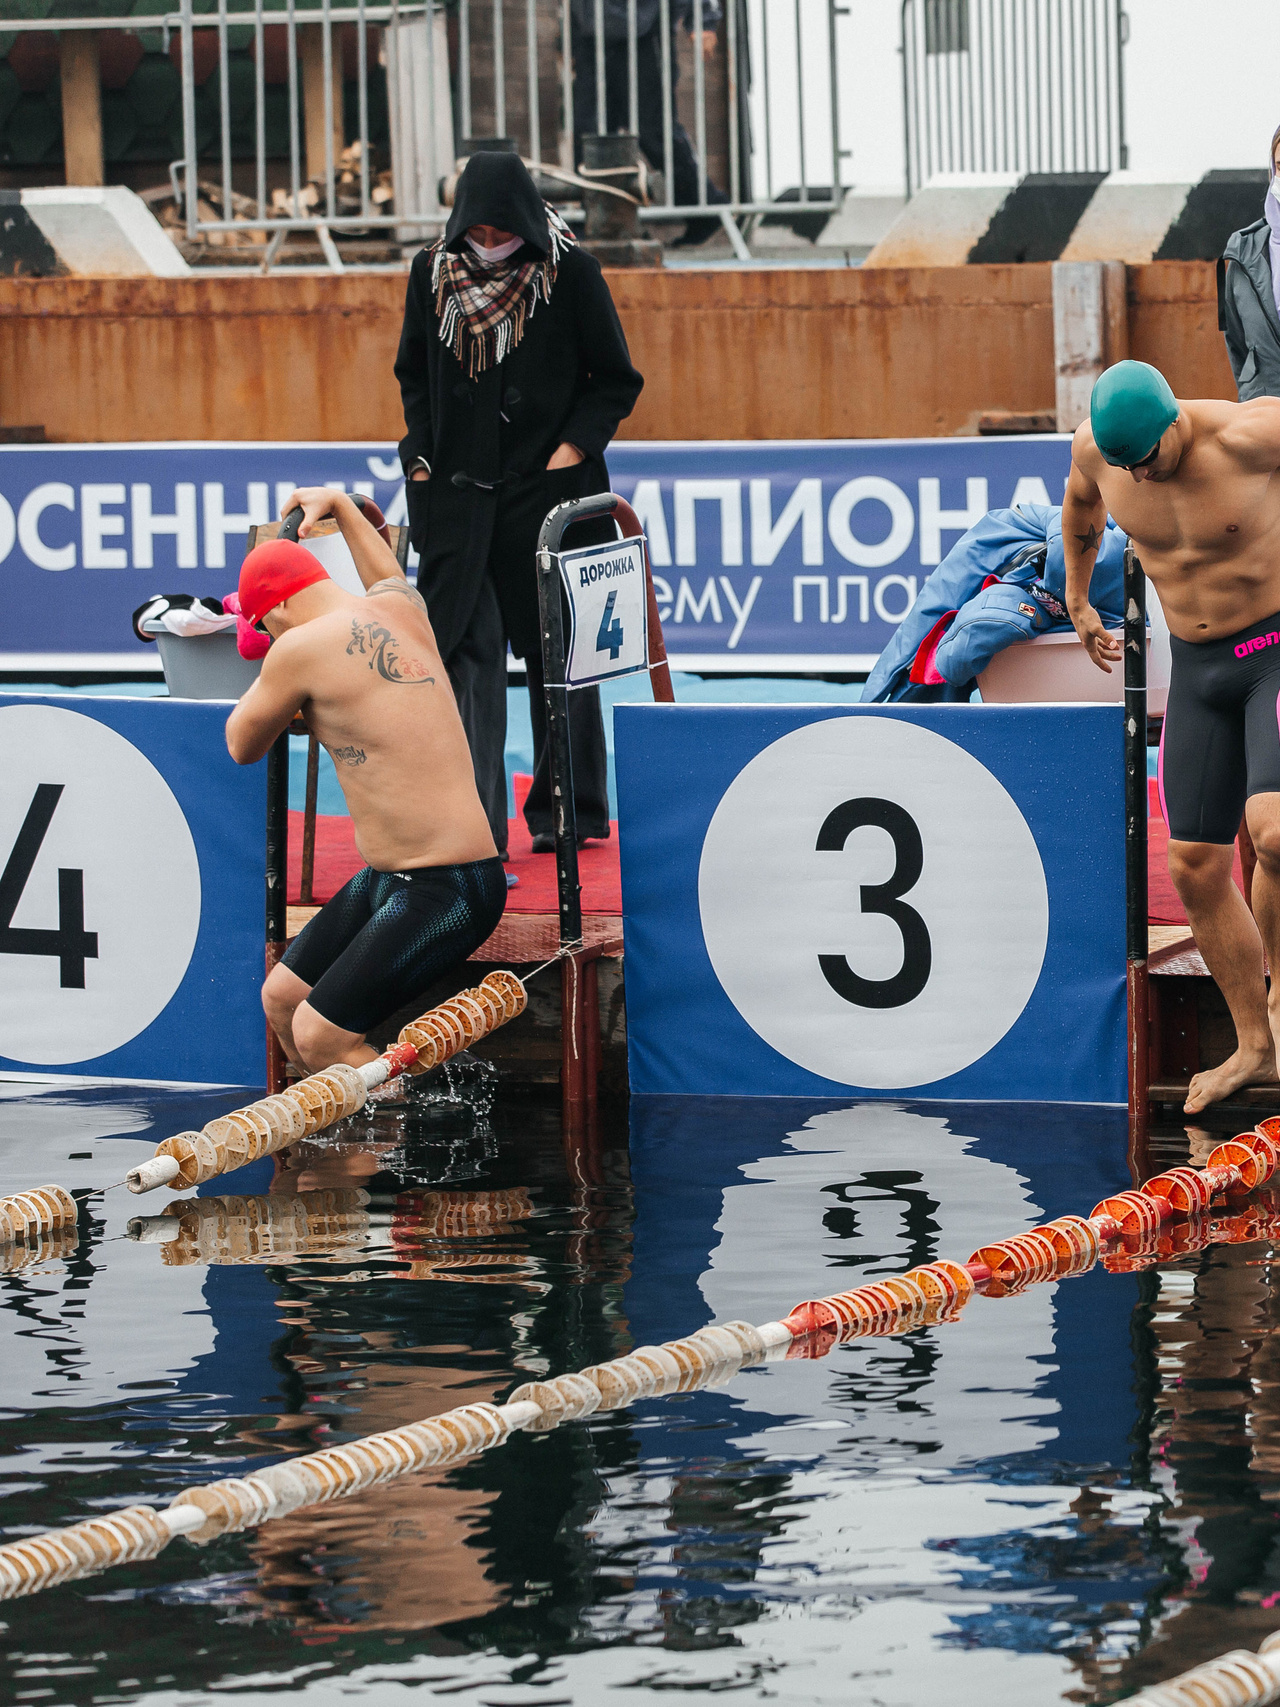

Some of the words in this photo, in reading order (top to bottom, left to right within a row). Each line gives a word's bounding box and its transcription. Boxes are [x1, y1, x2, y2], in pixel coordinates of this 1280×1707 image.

[0, 456, 420, 570] СЕНН
[613, 476, 1068, 567] ПИОН
[579, 555, 635, 588] ДОРОЖКА
[792, 574, 930, 624] пла
[596, 590, 624, 661] 4
[0, 783, 99, 989] 4
[815, 797, 932, 1009] 3
